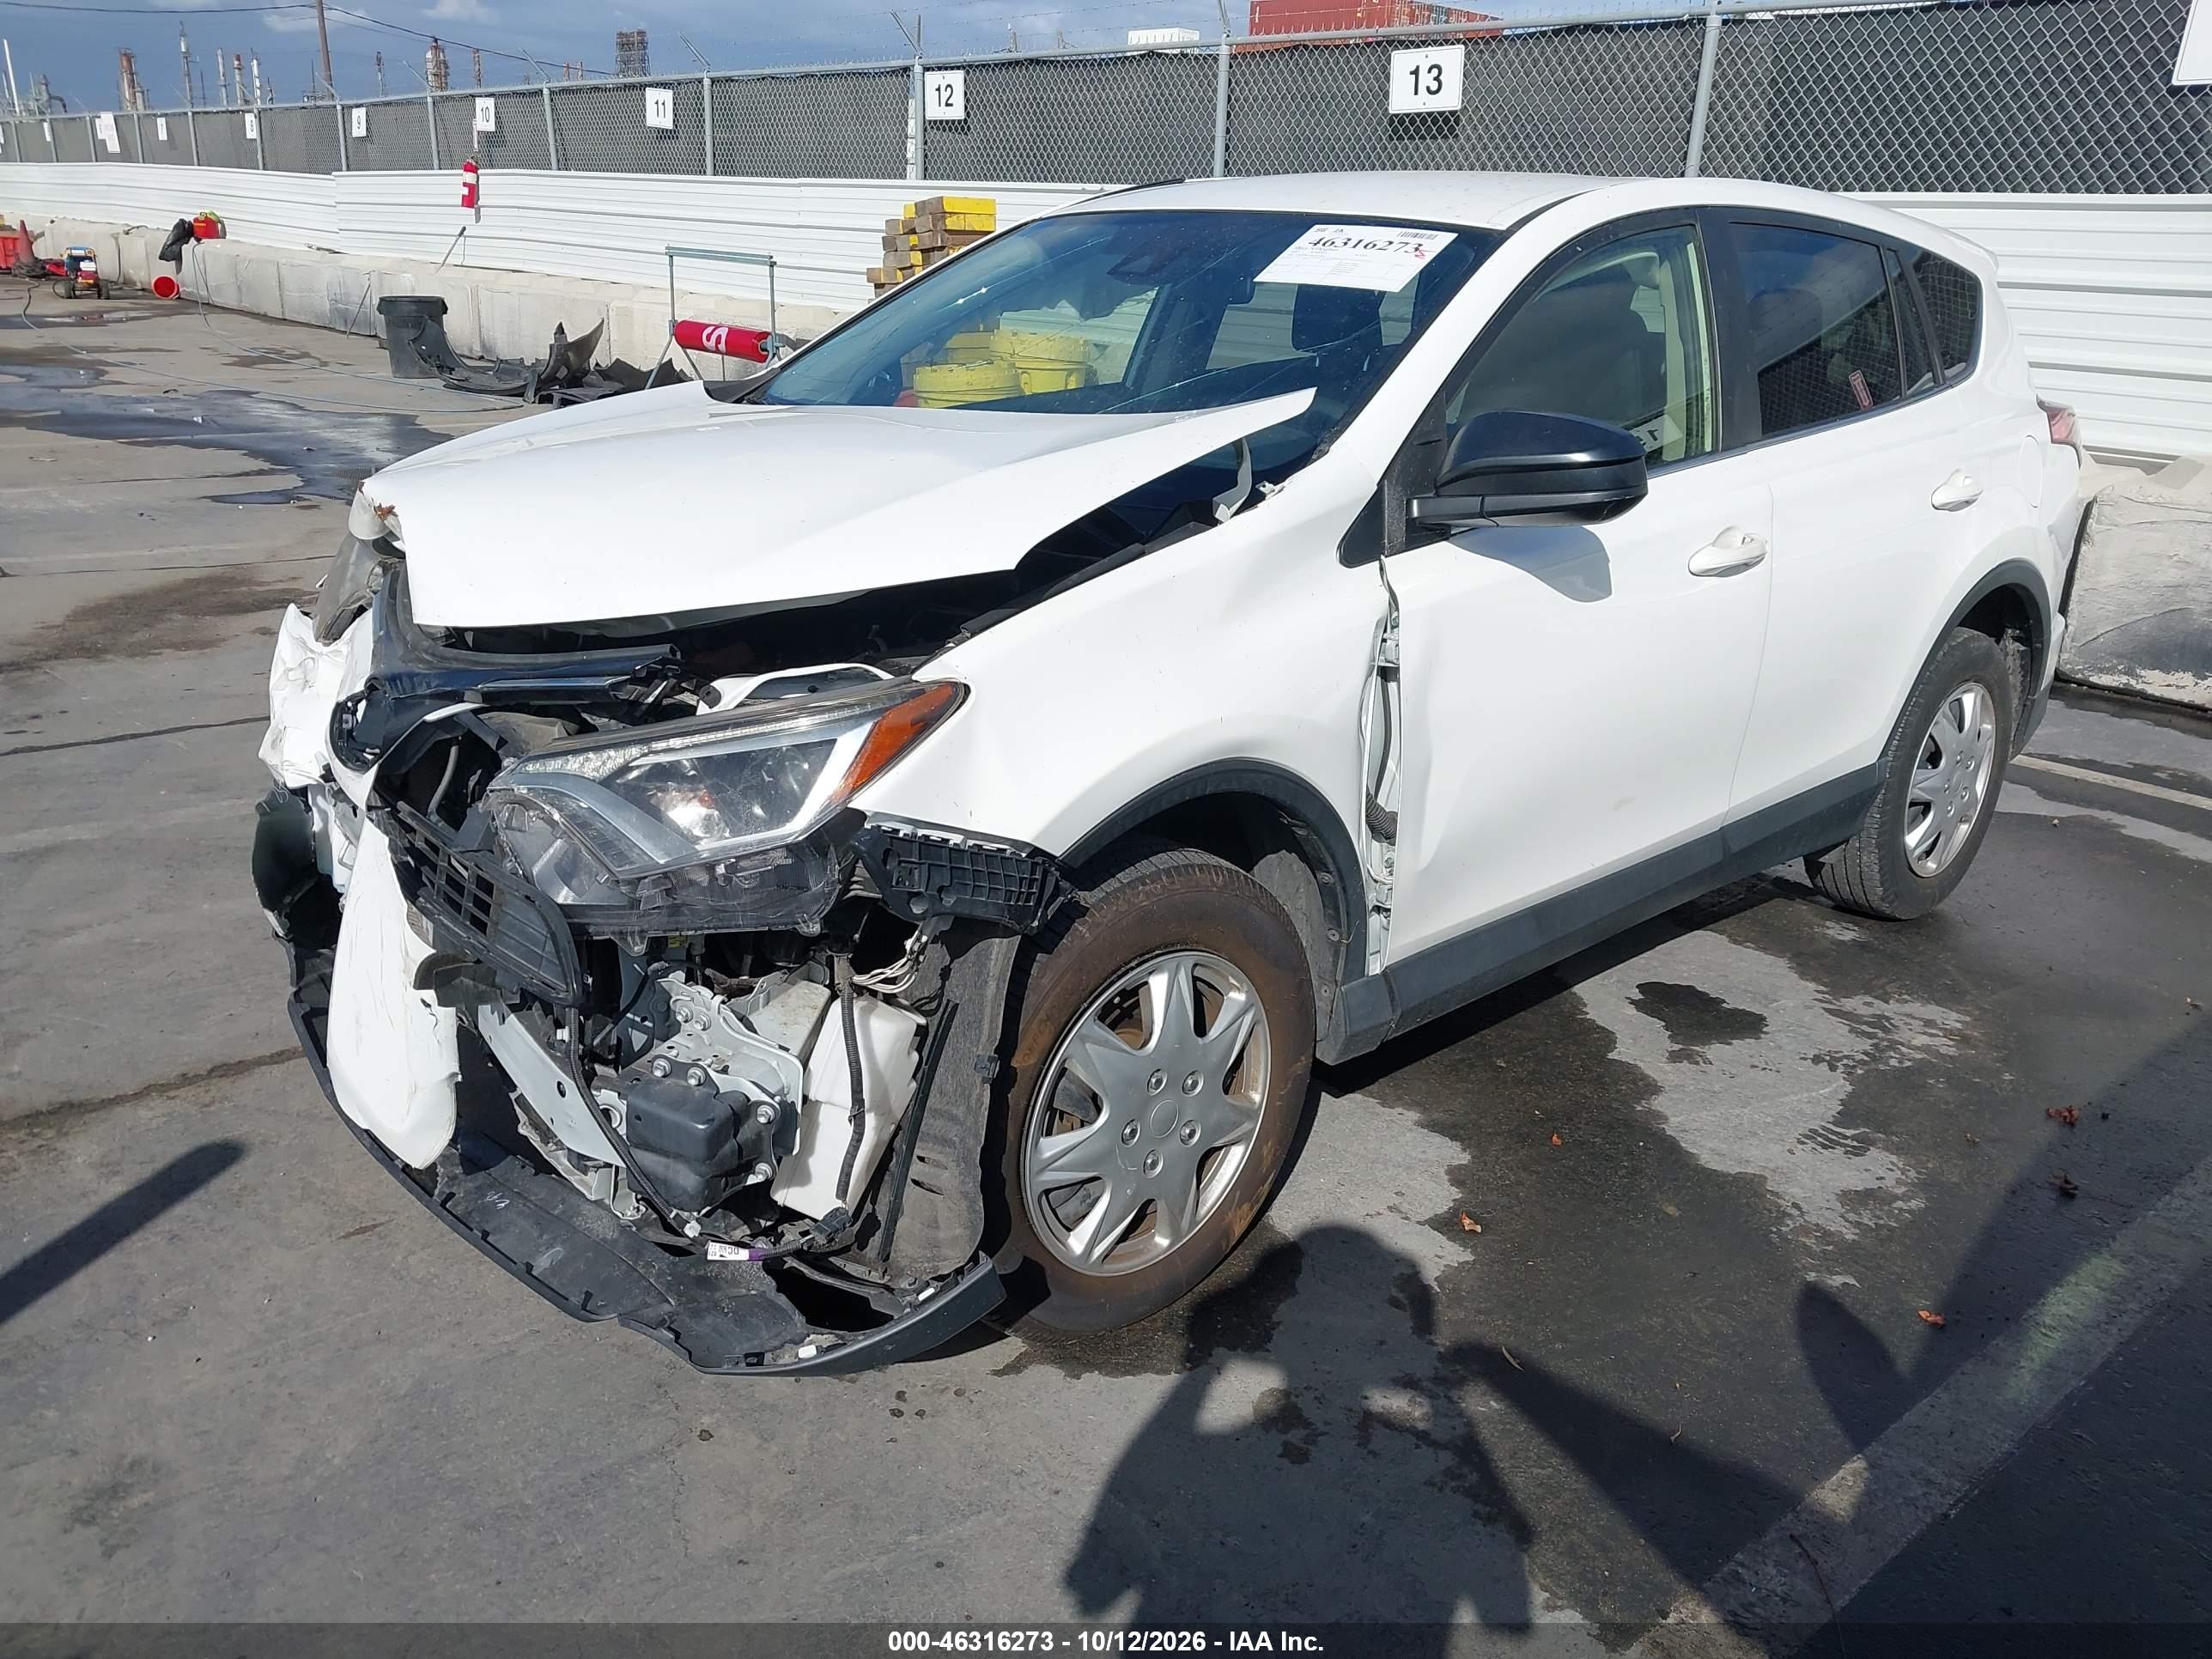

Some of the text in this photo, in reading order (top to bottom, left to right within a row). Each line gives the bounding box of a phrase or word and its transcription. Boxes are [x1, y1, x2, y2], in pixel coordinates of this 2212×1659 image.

[1408, 63, 1443, 96] 13
[934, 83, 954, 107] 12
[480, 106, 490, 123] 10
[653, 98, 665, 118] 11
[356, 115, 362, 130] 9
[1308, 236, 1424, 253] 46316273
